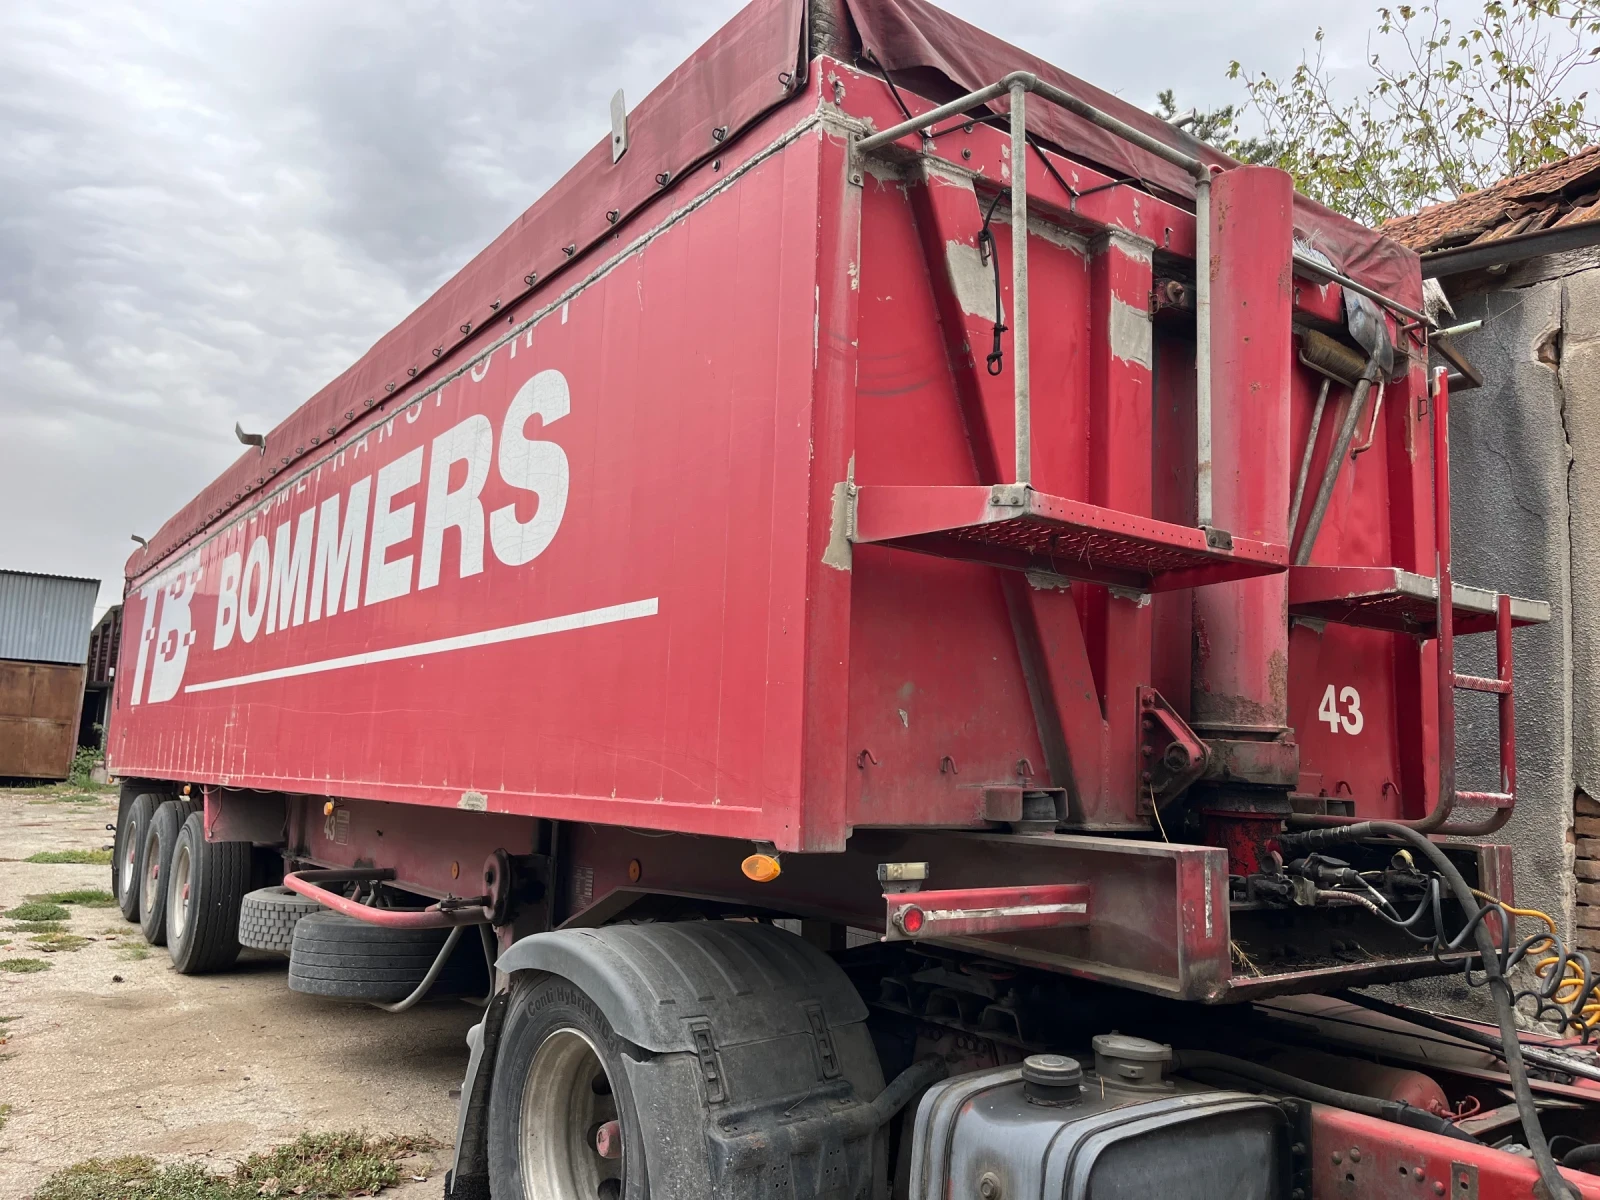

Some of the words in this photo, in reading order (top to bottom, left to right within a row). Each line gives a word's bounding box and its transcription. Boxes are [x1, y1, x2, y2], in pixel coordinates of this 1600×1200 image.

[213, 369, 571, 651] BOMMERS
[1319, 684, 1364, 736] 43
[324, 814, 336, 841] 43
[527, 987, 554, 1017] Conti
[557, 986, 592, 1017] Hybrid
